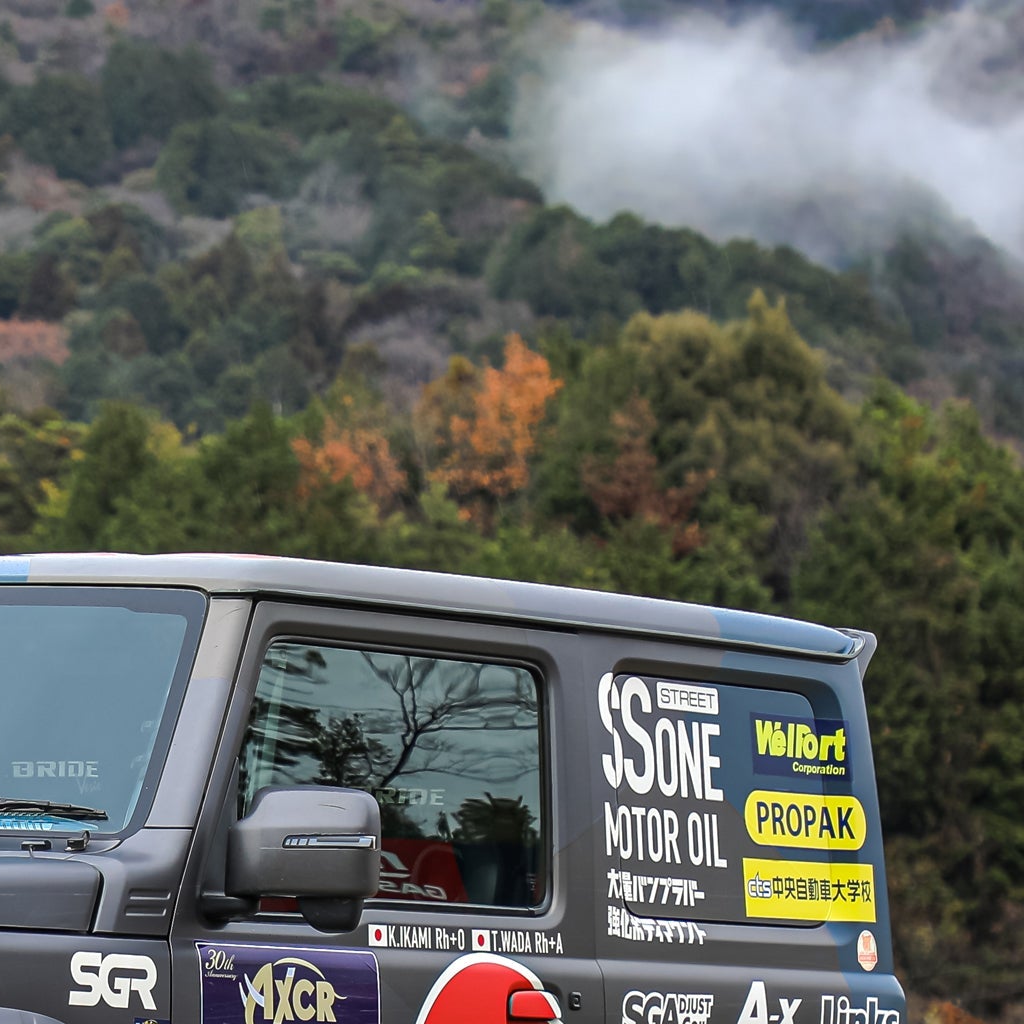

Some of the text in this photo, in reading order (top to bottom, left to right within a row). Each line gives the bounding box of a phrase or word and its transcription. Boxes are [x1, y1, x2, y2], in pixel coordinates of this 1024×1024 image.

[660, 687, 715, 709] STREET
[10, 760, 99, 778] BRIDE
[792, 761, 846, 776] Corporation
[756, 801, 856, 840] PROPAK
[604, 802, 728, 868] MOTOR OIL
[772, 876, 872, 903] 中央自動車大学校
[388, 925, 432, 949] K.IKAMI
[491, 930, 564, 954] T.WADA Rh+A
[205, 949, 236, 970] 30th
[68, 951, 158, 1010] SGR
